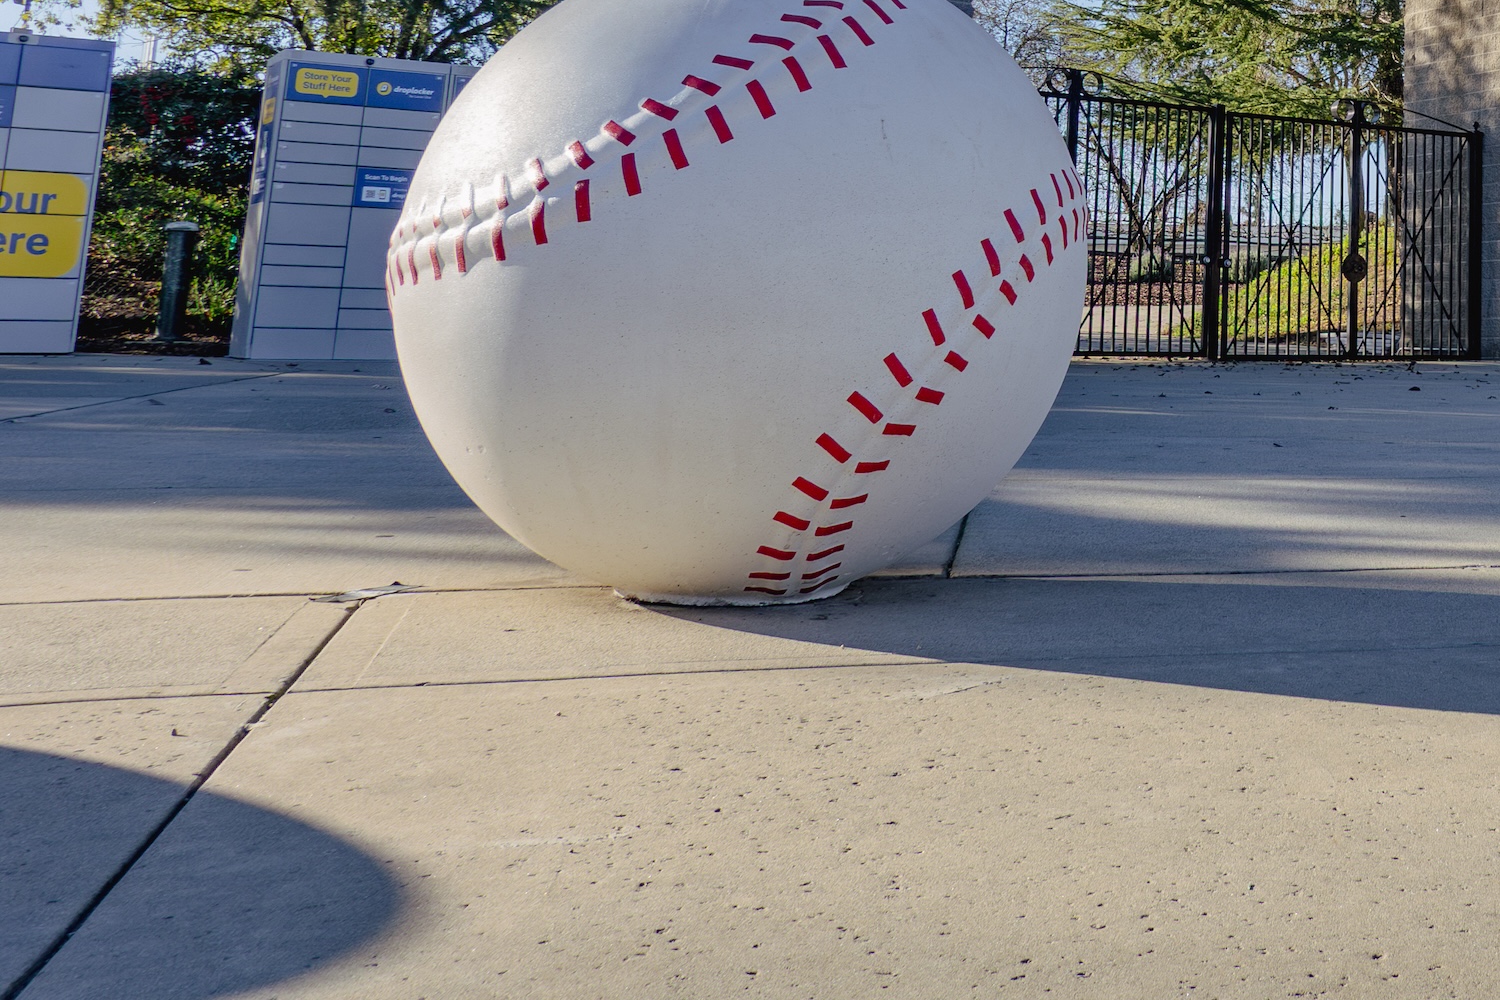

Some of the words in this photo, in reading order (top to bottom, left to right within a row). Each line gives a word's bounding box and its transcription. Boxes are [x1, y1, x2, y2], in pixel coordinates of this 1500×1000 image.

[304, 71, 328, 81] Store
[331, 74, 352, 84] Your
[303, 81, 326, 91] Stuff
[328, 84, 350, 93] Here
[393, 86, 435, 96] droplocker
[364, 173, 381, 181] Scan
[390, 175, 408, 183] Begin
